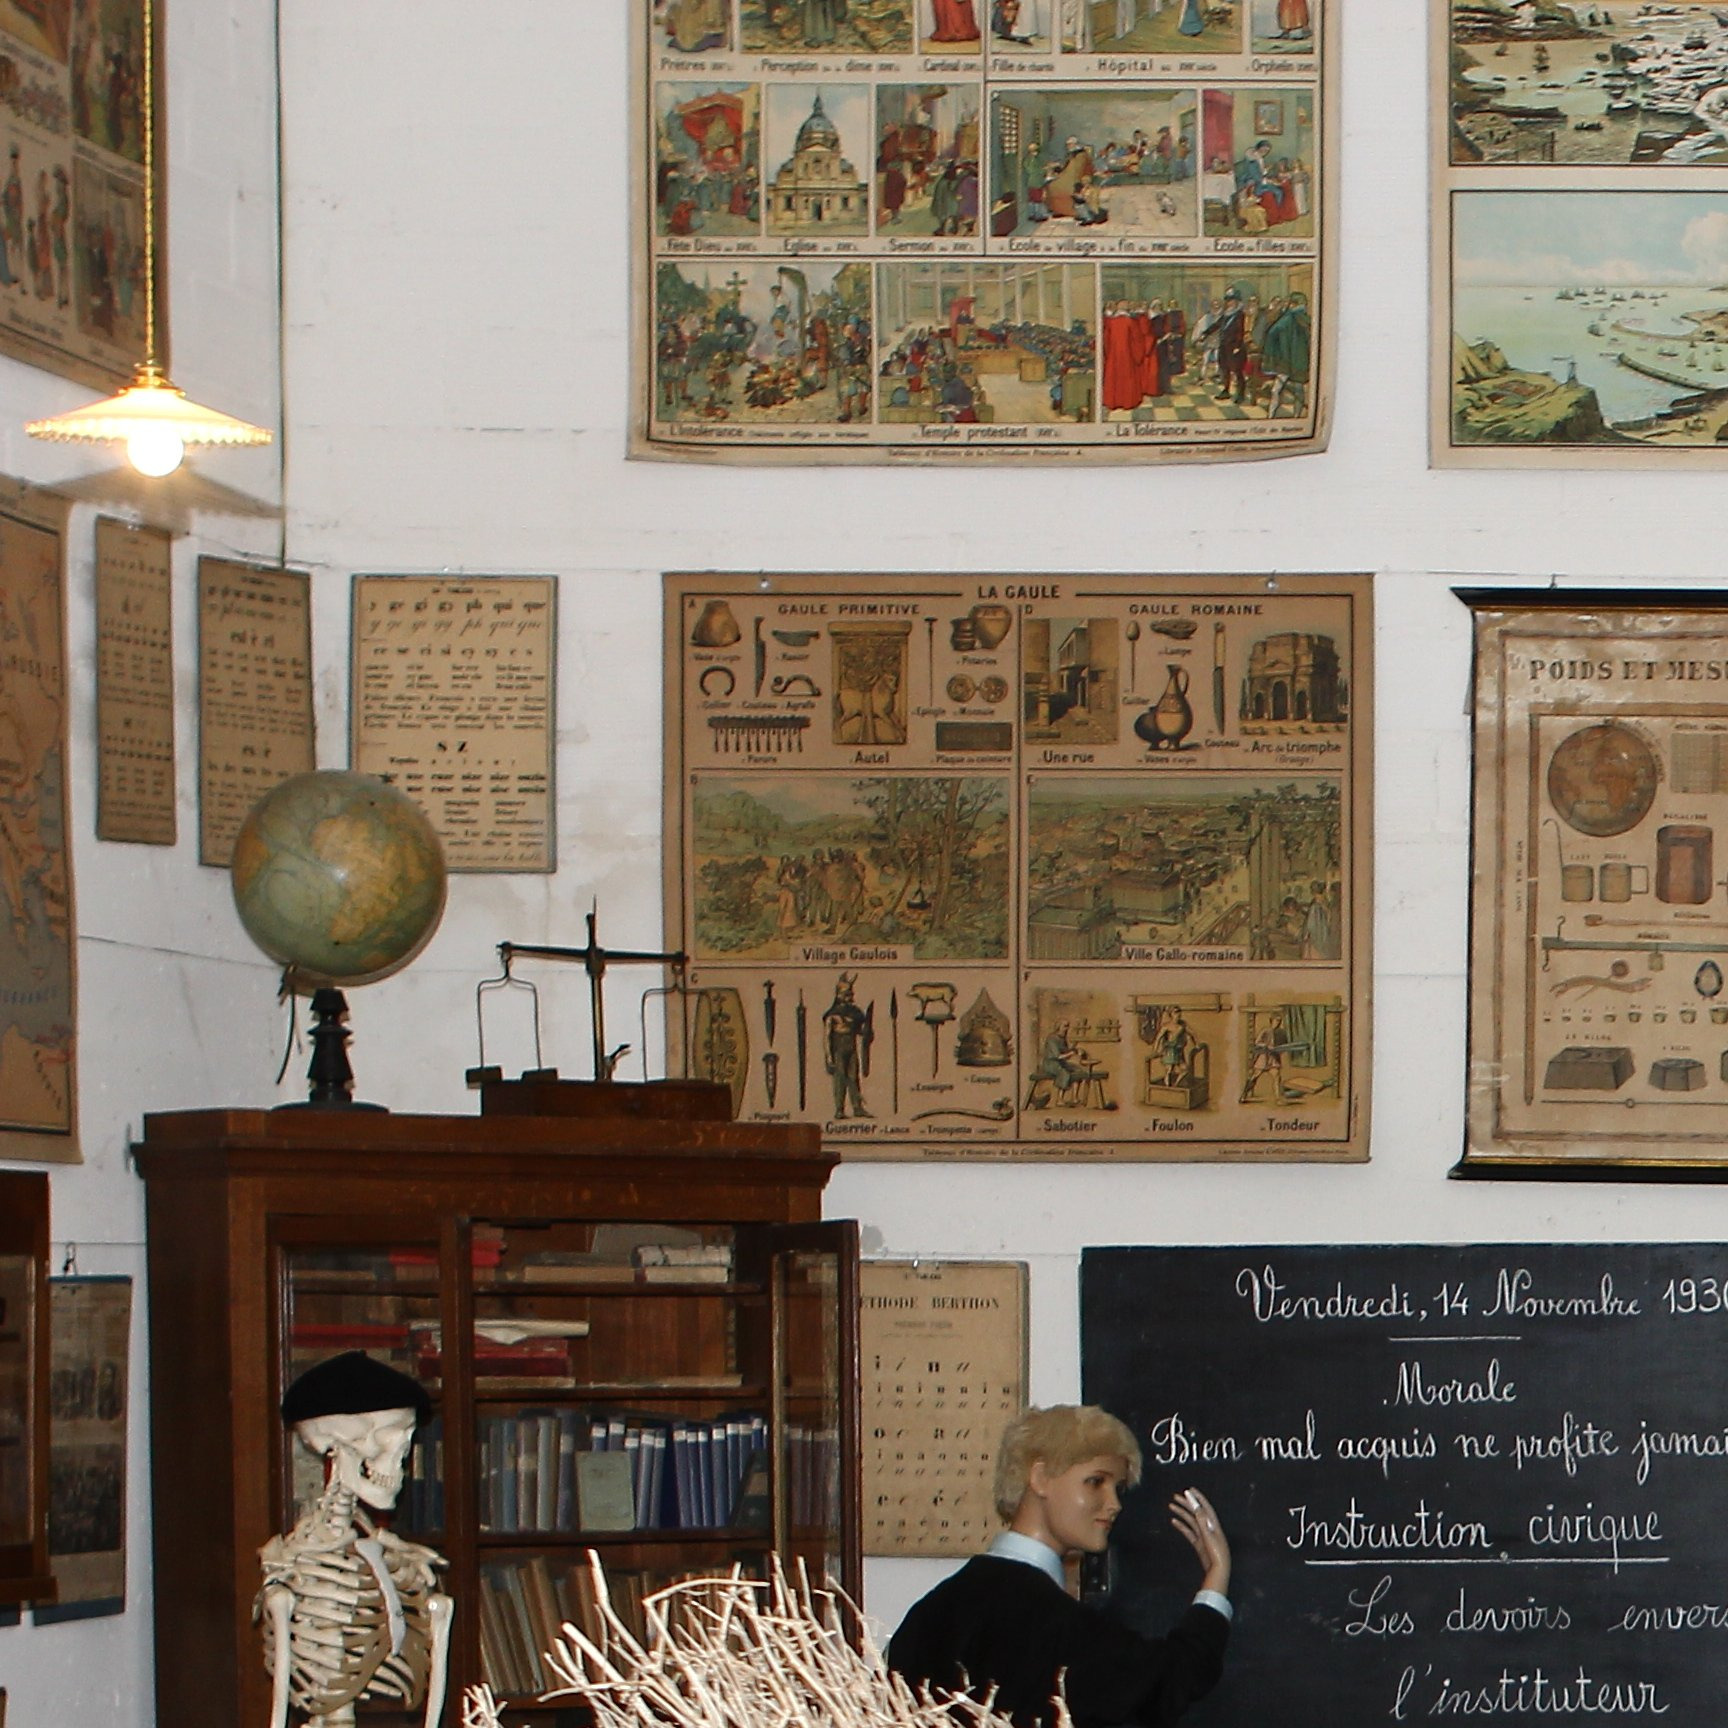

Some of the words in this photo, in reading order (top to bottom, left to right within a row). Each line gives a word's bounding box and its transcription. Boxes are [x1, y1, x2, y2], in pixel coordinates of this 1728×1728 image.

[978, 586, 999, 599] LA
[1005, 586, 1060, 599] GAULE
[778, 604, 828, 615] GAULE
[839, 604, 920, 615] PRIMITIVE
[1129, 604, 1180, 615] GAULE
[1191, 604, 1264, 616] ROMAINE
[1529, 660, 1613, 681] POIDS
[1622, 660, 1657, 680] ET
[855, 752, 889, 763] Autel
[802, 947, 847, 965] Village
[850, 948, 897, 961] Gaulois
[1125, 947, 1152, 960] Ville
[1043, 1119, 1097, 1132] Sabotier
[1152, 1119, 1194, 1132] Foulon
[1267, 1118, 1320, 1131] Tondeur
[1432, 1285, 1469, 1319] 14
[1482, 1267, 1642, 1319] Novembre
[932, 1296, 1000, 1309] BERTHON
[1387, 1358, 1517, 1406] Morale
[1150, 1412, 1245, 1466] Bien
[1256, 1409, 1322, 1462] mal
[1336, 1431, 1438, 1480] acquis
[1454, 1434, 1501, 1459] ne
[1512, 1412, 1620, 1479] profite
[1286, 1497, 1493, 1551] Instruction
[1527, 1505, 1664, 1575] civique
[1345, 1576, 1416, 1637] Les
[1445, 1587, 1573, 1633] devoirs
[1390, 1663, 1670, 1721] l'instituteur
